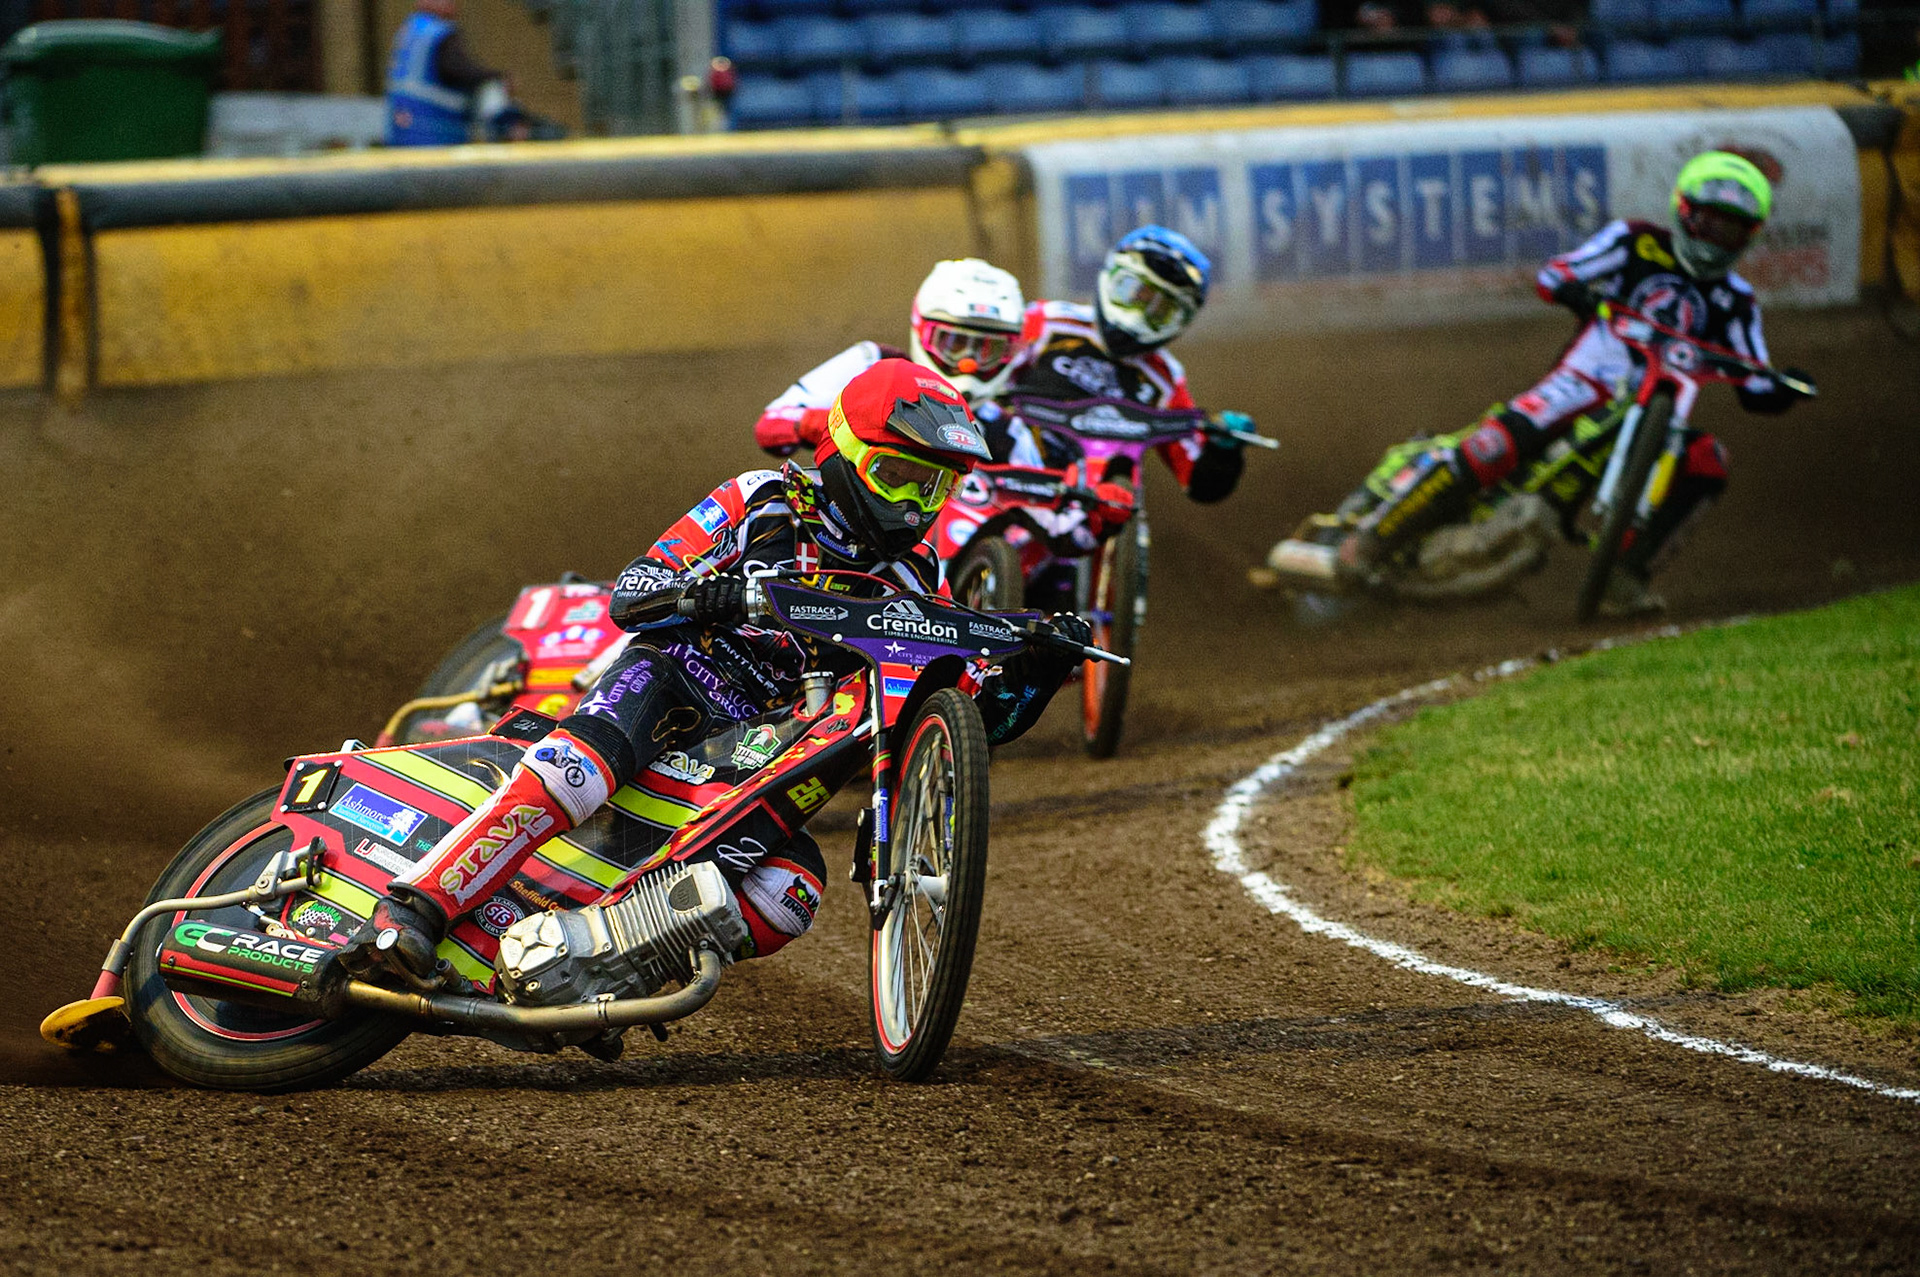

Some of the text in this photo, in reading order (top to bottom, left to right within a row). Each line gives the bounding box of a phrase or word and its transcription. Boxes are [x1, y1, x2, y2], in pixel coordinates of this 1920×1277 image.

[1261, 167, 1600, 251] SYSTEMS
[522, 588, 553, 630] 1
[789, 605, 836, 615] FASTRACK
[866, 614, 958, 640] Crendon
[884, 630, 958, 646] TIMBER ENGINEERING
[969, 621, 1013, 637] FASTRACK
[686, 660, 726, 691] CITY
[714, 637, 781, 698] PANTHERS
[607, 683, 627, 704] CITY
[294, 768, 330, 804] 1
[338, 795, 388, 823] Ashmore
[415, 838, 433, 853] THE
[439, 804, 547, 896] STAVA
[368, 851, 407, 875] ENGINEERIN
[510, 880, 547, 908] Sheffield
[486, 904, 512, 925] STS
[227, 946, 315, 975] PRODUCTS
[231, 934, 325, 964] RACE
